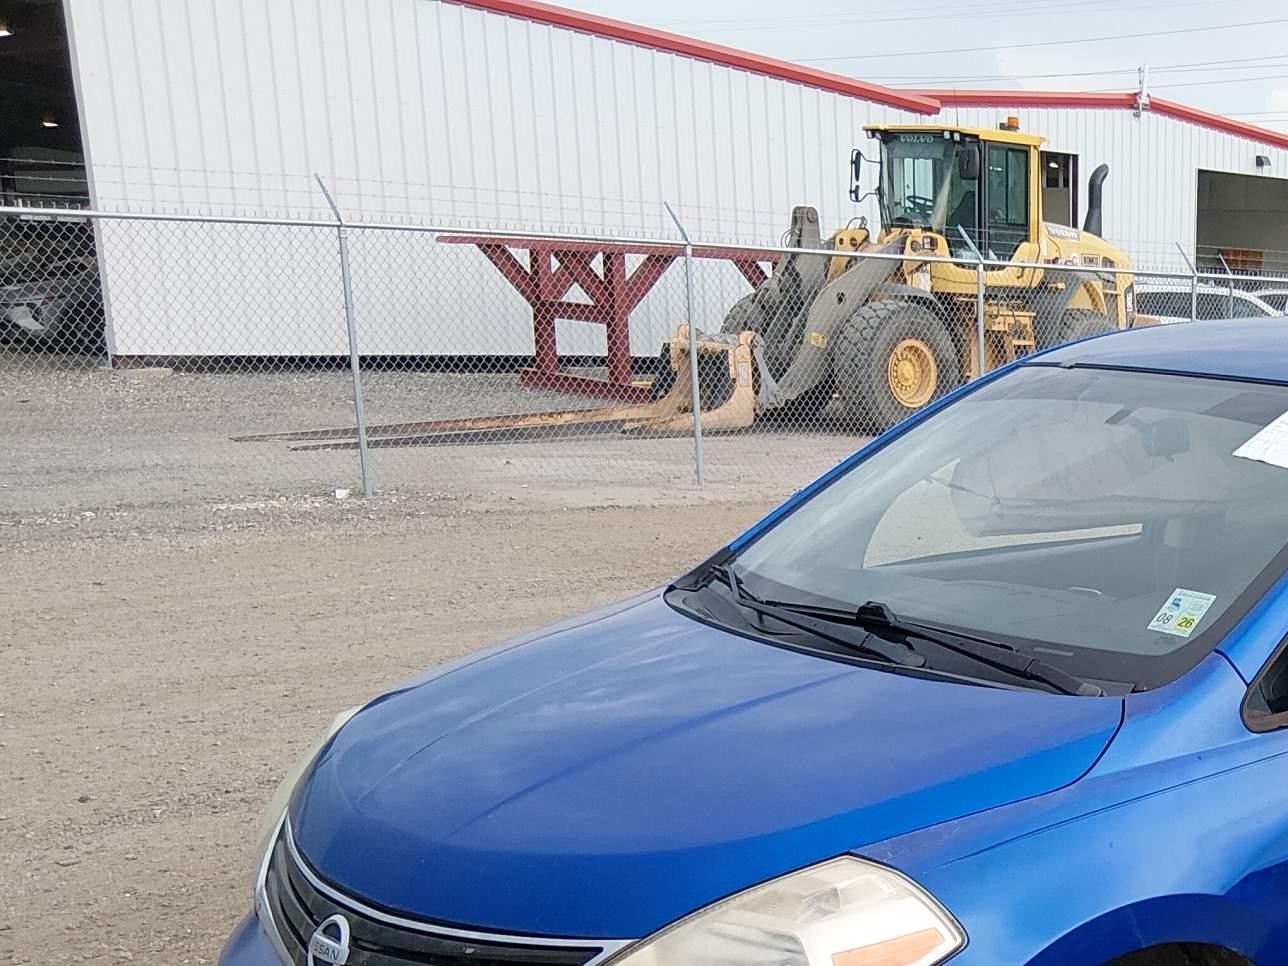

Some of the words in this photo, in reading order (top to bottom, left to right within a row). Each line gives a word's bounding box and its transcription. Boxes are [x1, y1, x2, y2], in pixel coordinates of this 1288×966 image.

[900, 135, 934, 143] VOLVO
[1156, 613, 1173, 624] 08
[1177, 617, 1194, 628] 26
[311, 939, 340, 961] SSAN
